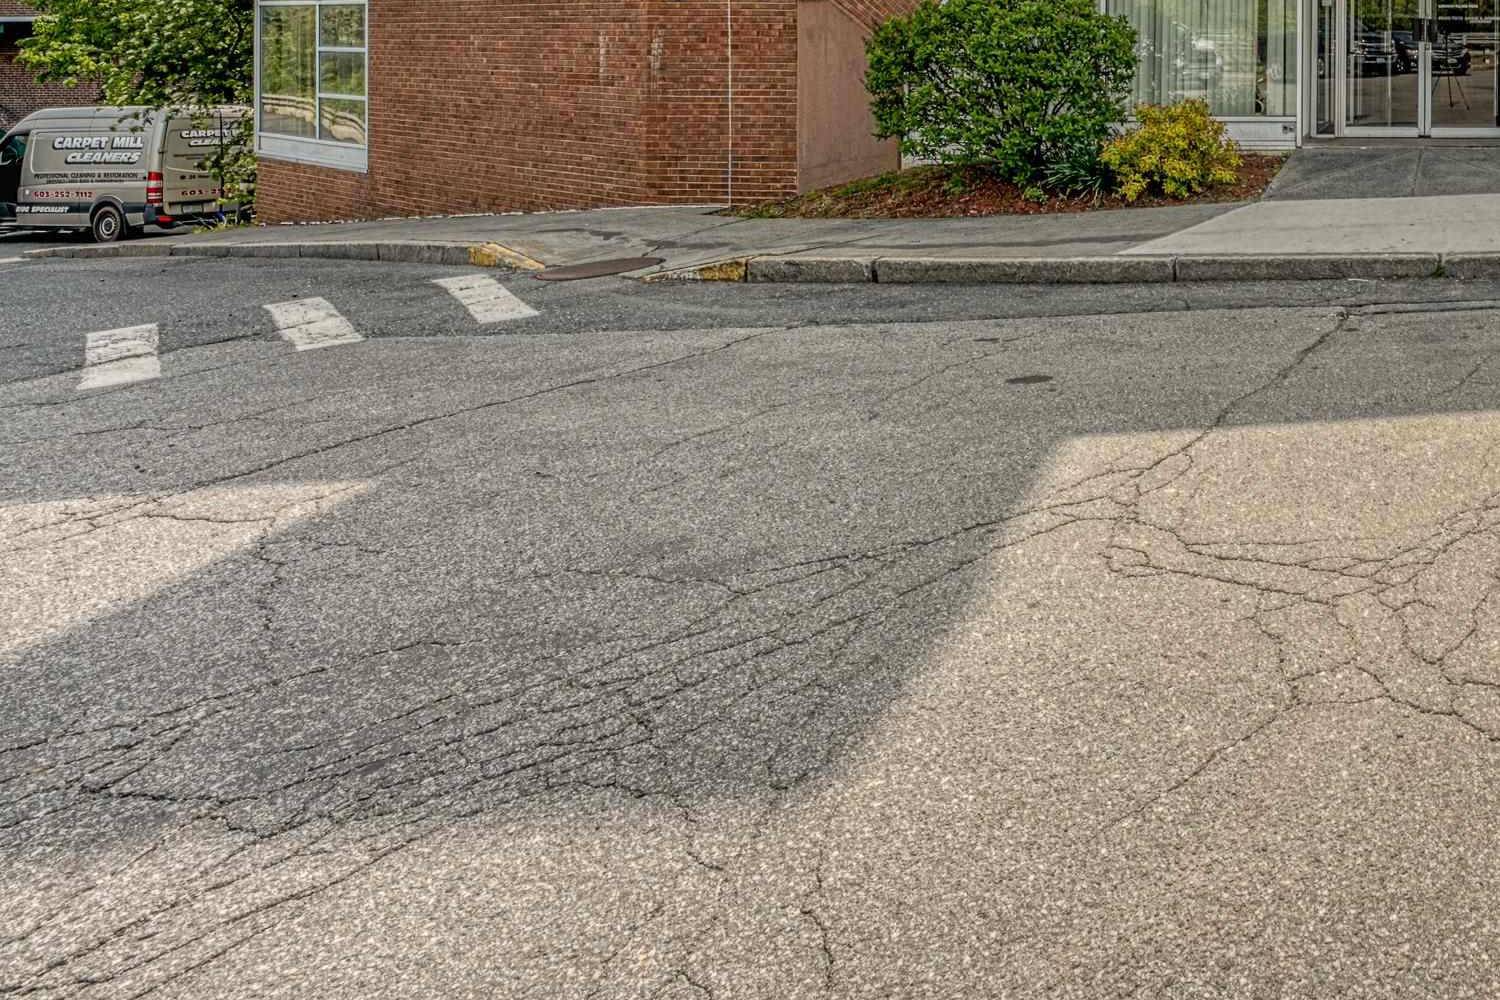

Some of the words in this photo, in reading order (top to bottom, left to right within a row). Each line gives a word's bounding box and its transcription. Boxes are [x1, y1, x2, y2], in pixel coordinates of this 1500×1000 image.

[53, 136, 108, 150] CARPET
[111, 136, 143, 150] MILL
[65, 152, 141, 164] CLEANERS
